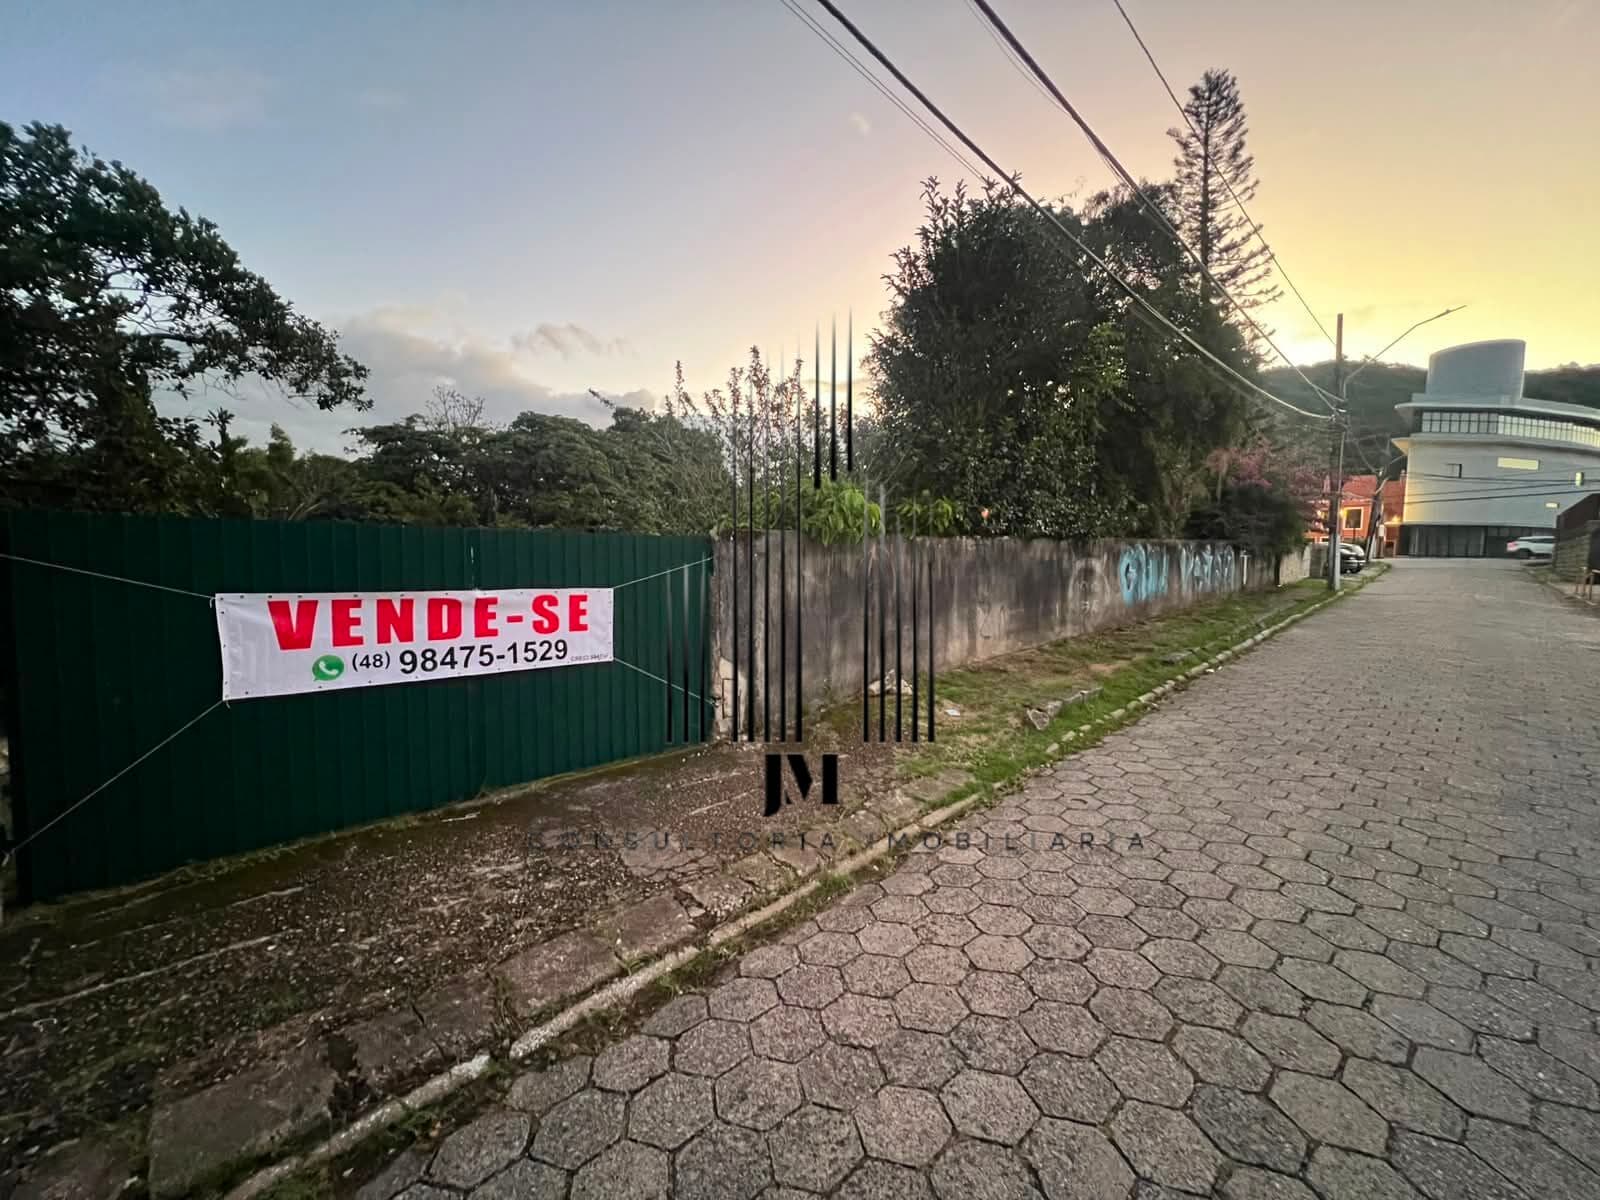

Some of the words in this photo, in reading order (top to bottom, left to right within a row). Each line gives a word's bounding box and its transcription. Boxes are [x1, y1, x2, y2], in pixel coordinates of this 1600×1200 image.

[268, 594, 589, 650] VENDE-SE
[351, 651, 391, 673] (48)
[399, 639, 568, 674] 98475-1529
